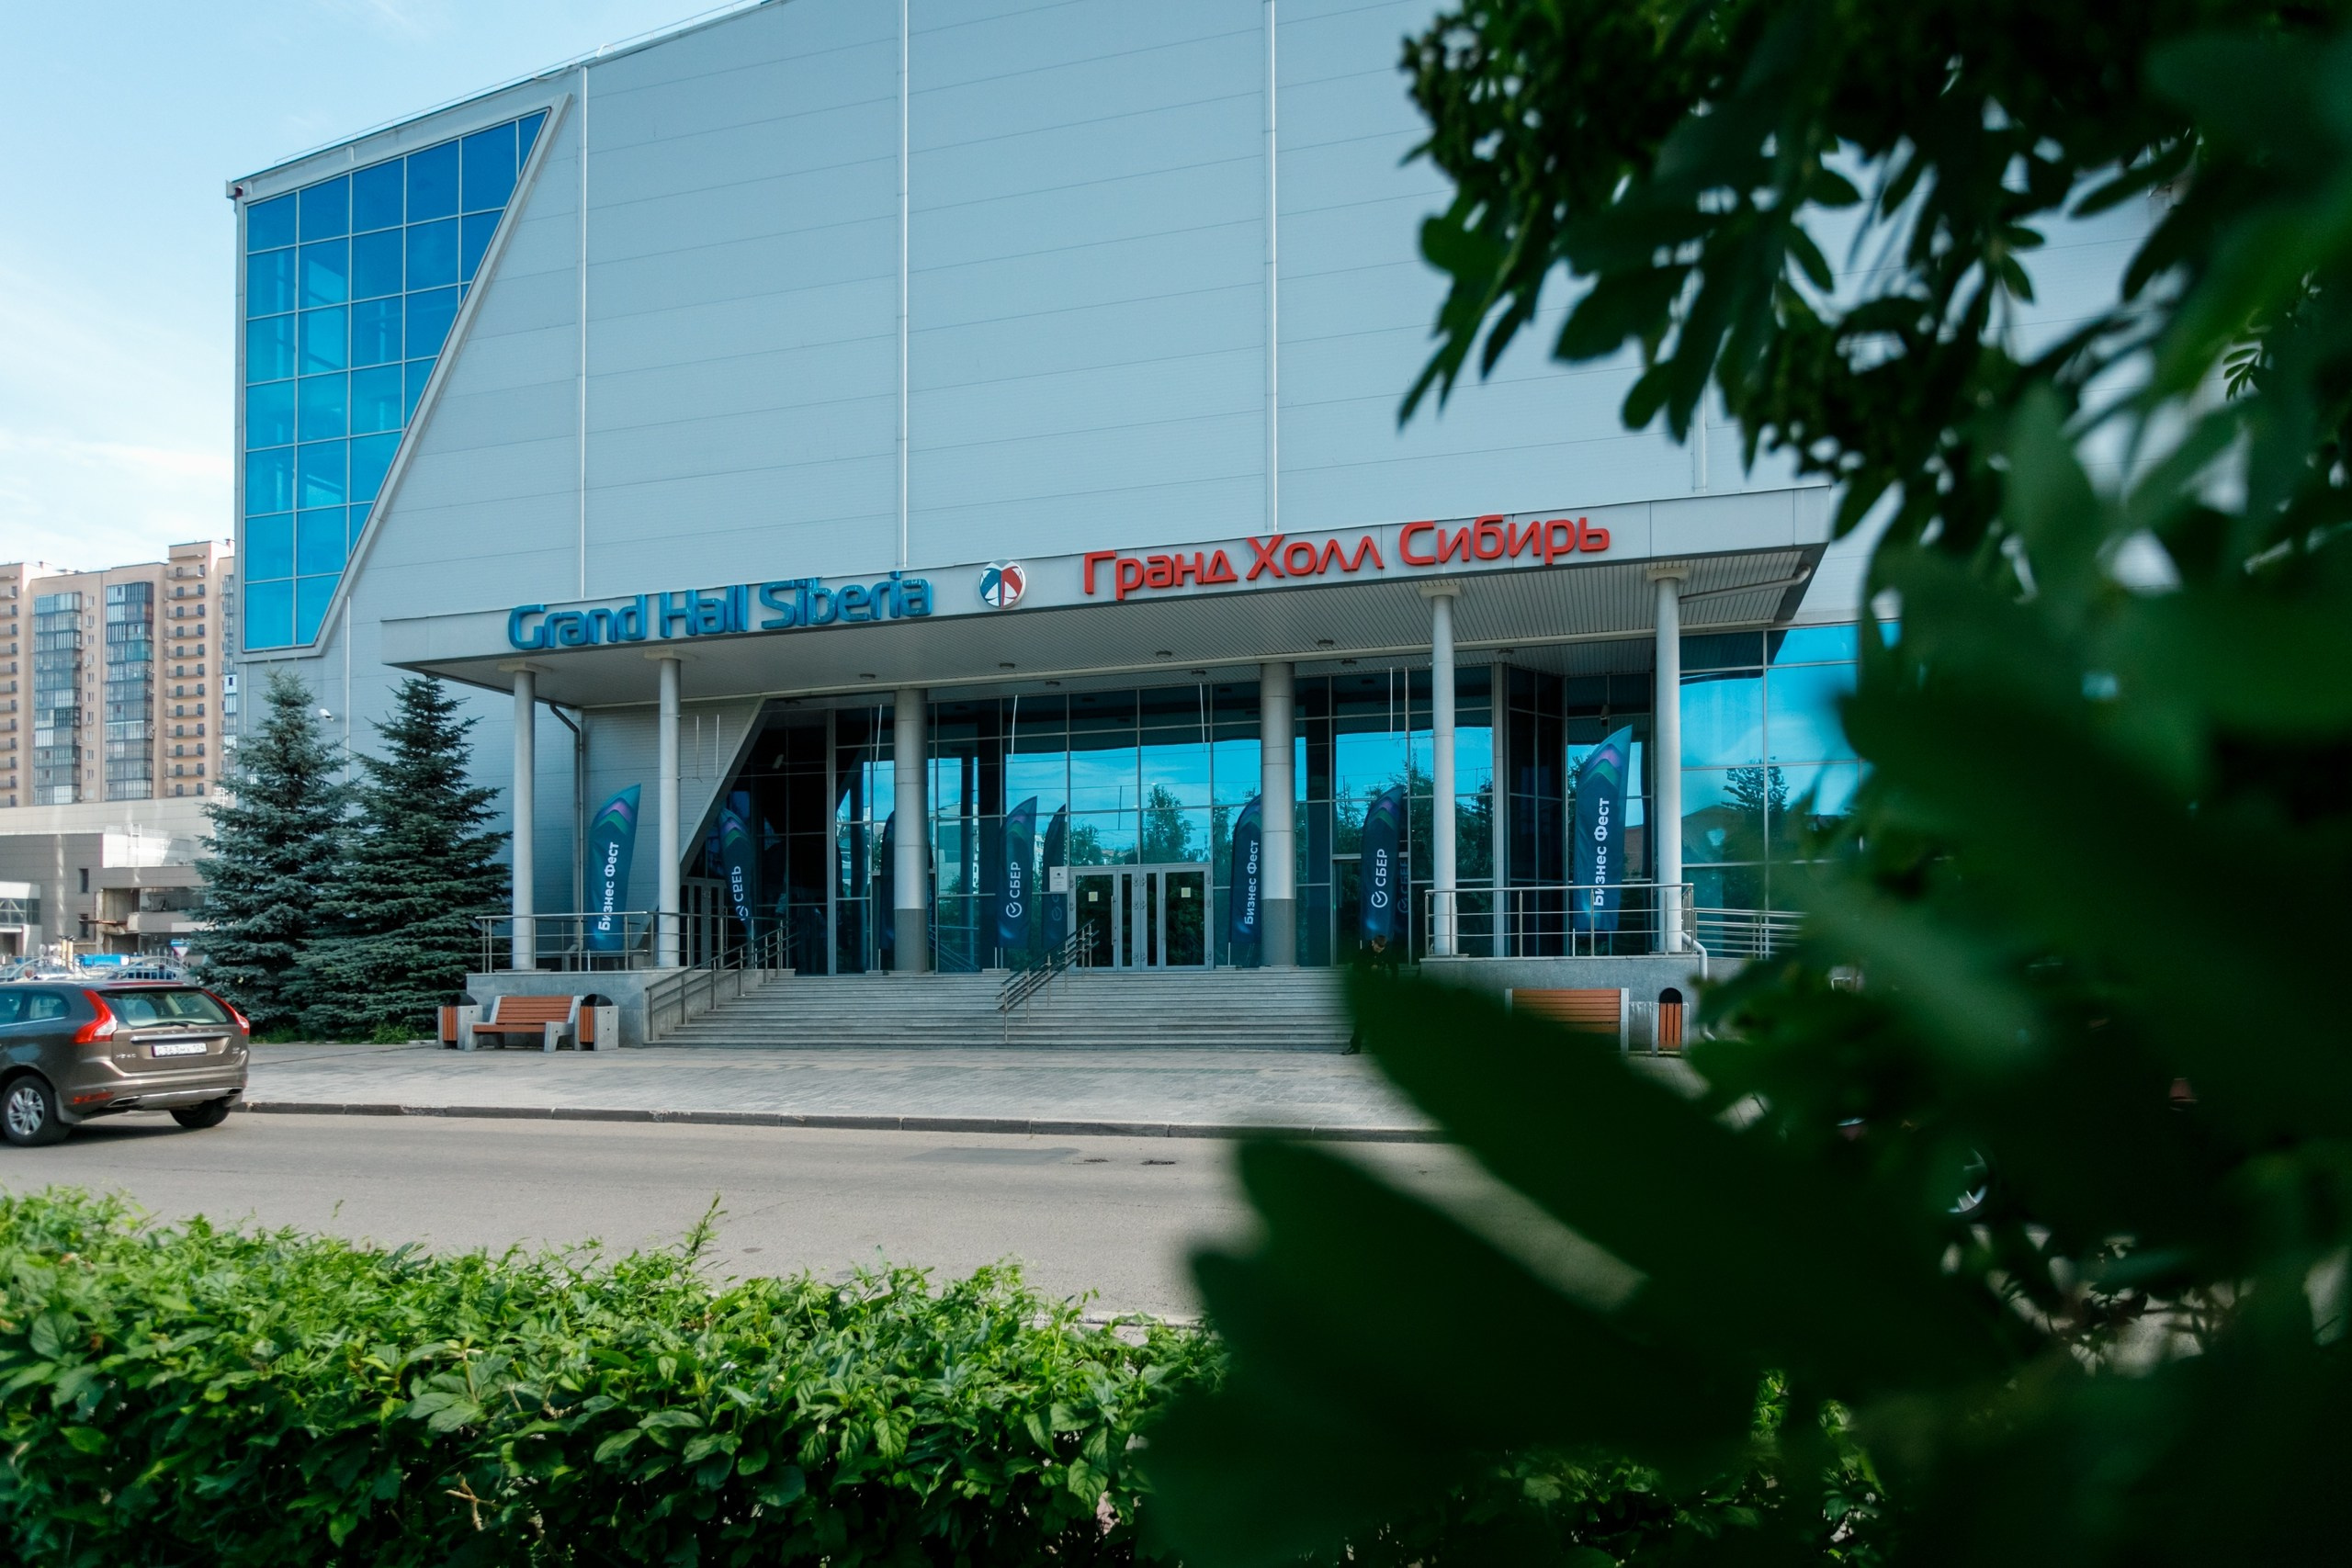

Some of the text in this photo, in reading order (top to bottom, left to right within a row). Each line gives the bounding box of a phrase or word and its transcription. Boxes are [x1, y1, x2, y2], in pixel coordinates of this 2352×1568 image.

[1084, 514, 1611, 601] Гранд Холл Сибирь
[507, 570, 933, 650] Grand Hall Siberia
[1594, 797, 1610, 841] Фест
[597, 841, 619, 931] Бизнес Фест
[1009, 862, 1021, 898] СБЕР
[1244, 840, 1259, 925] Бизнес Фест
[1375, 848, 1387, 887] СБЕР
